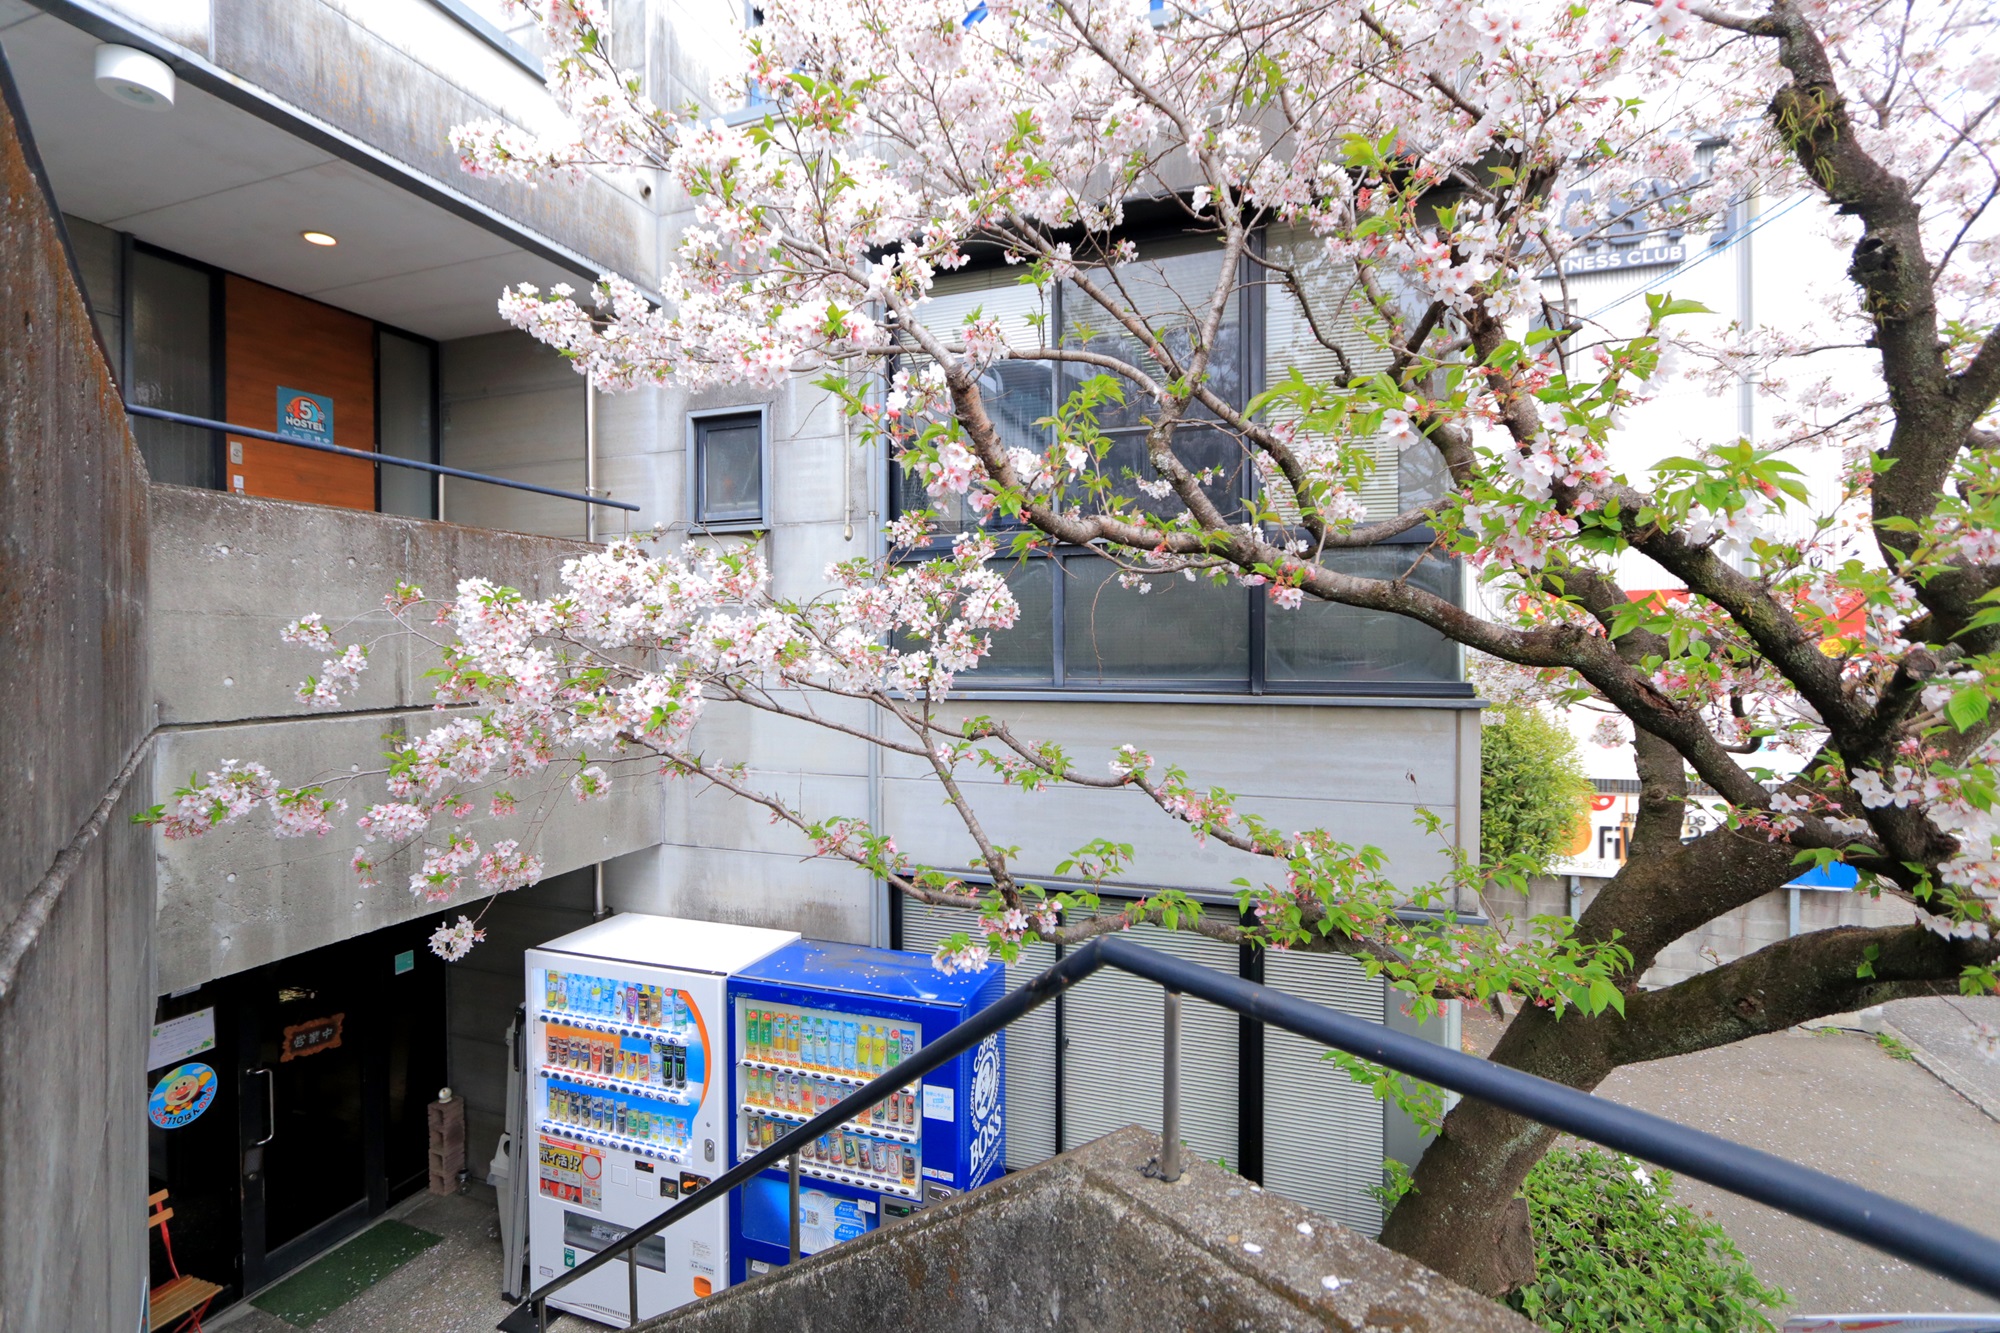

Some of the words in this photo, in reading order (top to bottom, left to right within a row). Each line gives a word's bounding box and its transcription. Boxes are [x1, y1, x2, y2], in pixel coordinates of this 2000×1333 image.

[1550, 251, 1621, 275] TNESS
[1626, 245, 1683, 265] CLUB
[299, 400, 313, 420] 5
[285, 415, 326, 432] HOSTEL
[294, 1028, 333, 1048] 営業中
[970, 1104, 1002, 1176] BOSS
